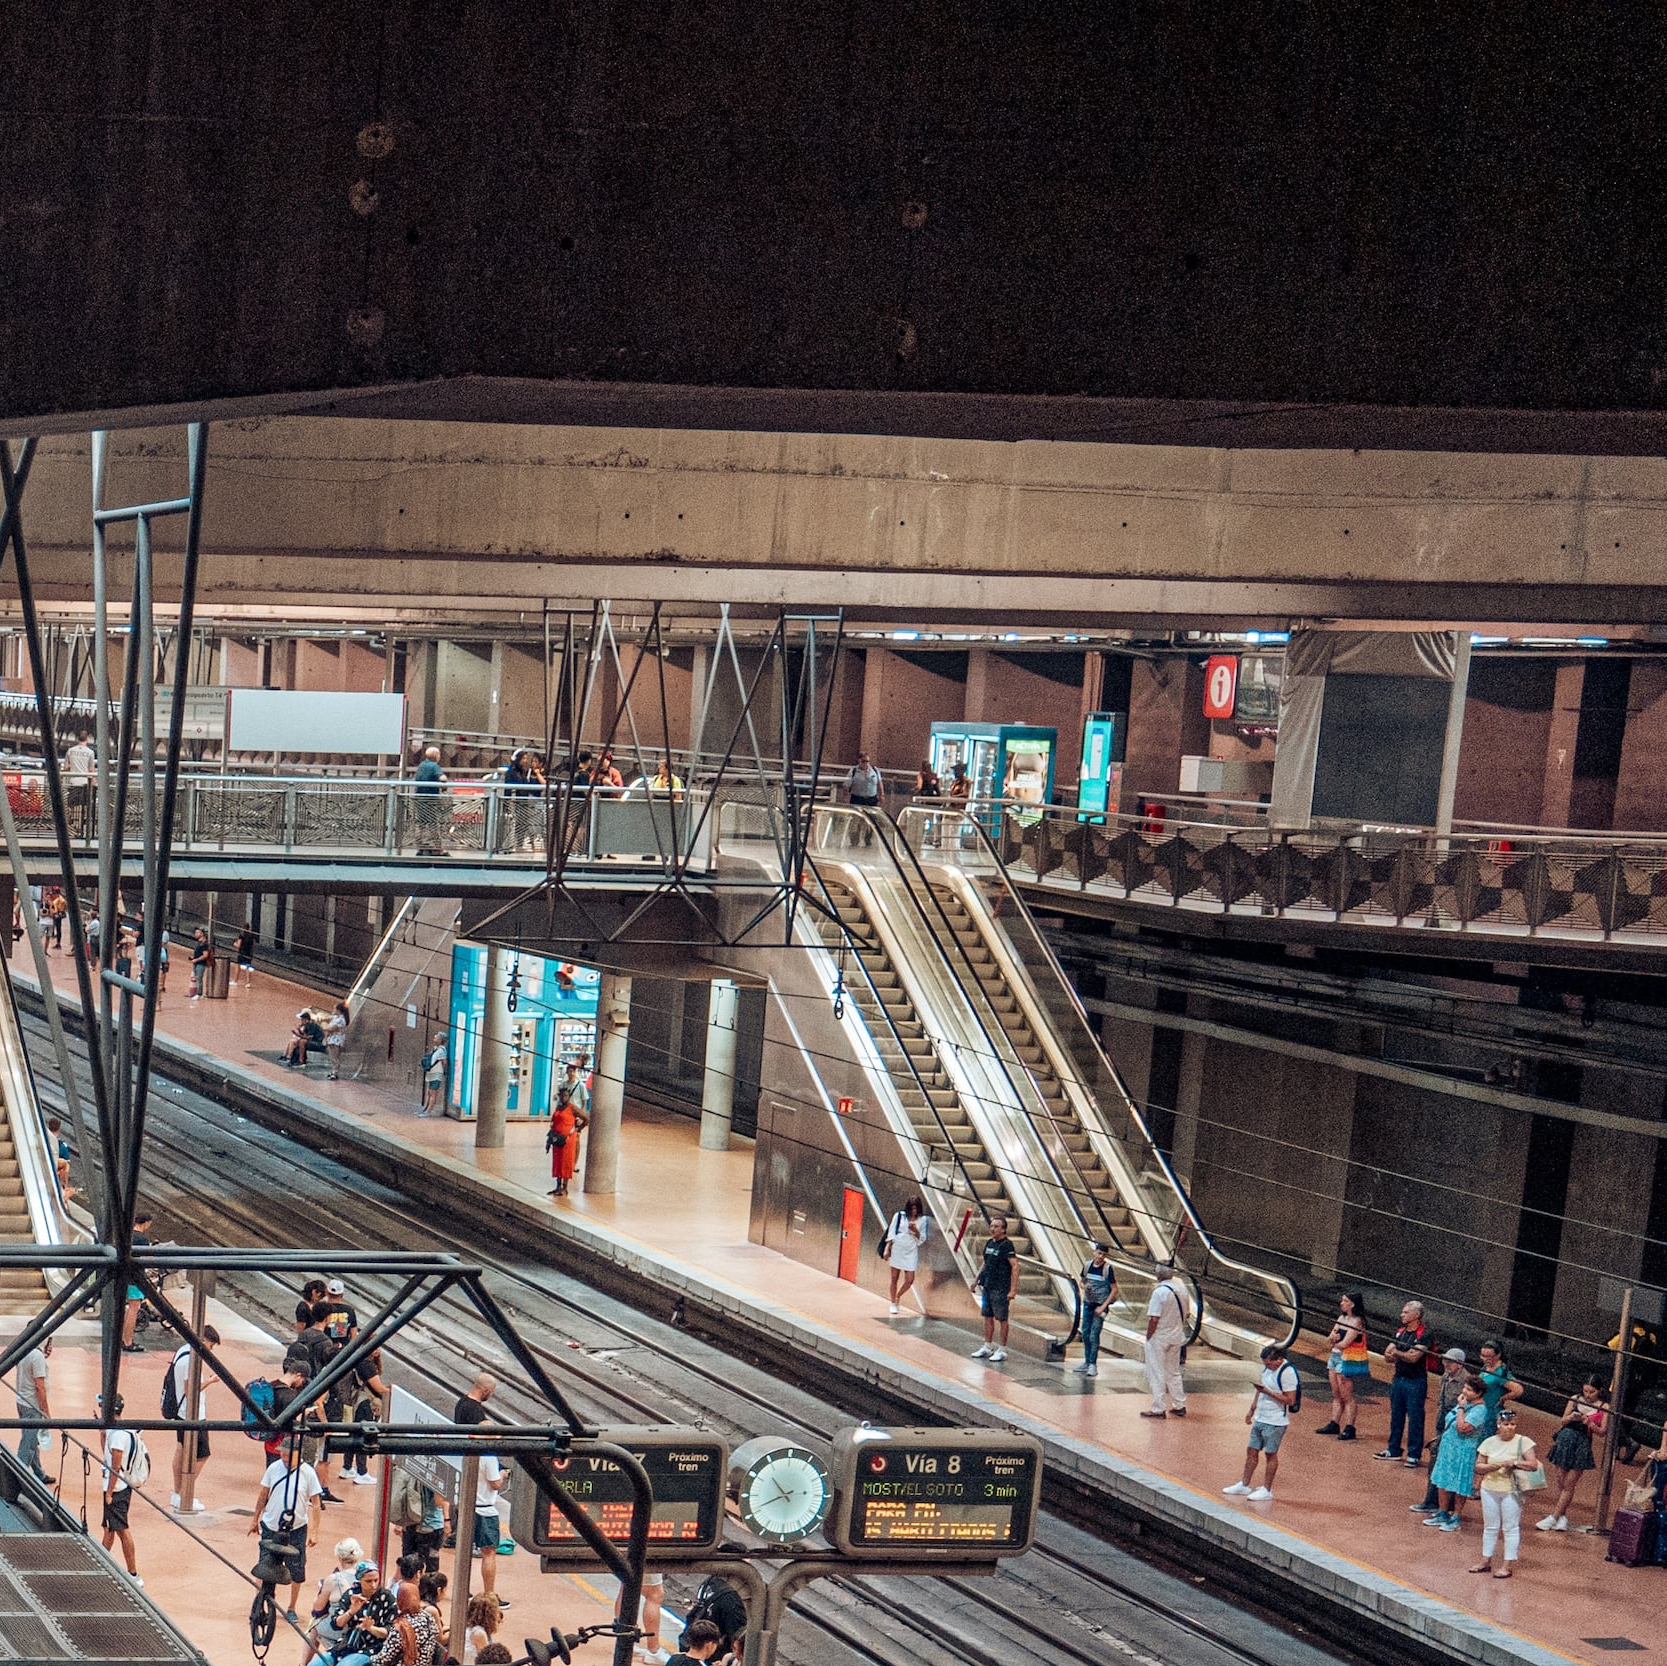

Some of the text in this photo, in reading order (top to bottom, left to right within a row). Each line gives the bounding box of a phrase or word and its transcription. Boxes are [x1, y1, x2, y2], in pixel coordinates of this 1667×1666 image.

[668, 1452, 709, 1463] Próximo
[985, 1456, 1025, 1466] Próximo
[678, 1462, 699, 1471] tren
[905, 1454, 961, 1474] Vía 8
[994, 1465, 1014, 1475] tren
[925, 1484, 964, 1496] SOTO
[983, 1485, 994, 1496] 3
[995, 1485, 1018, 1497] min
